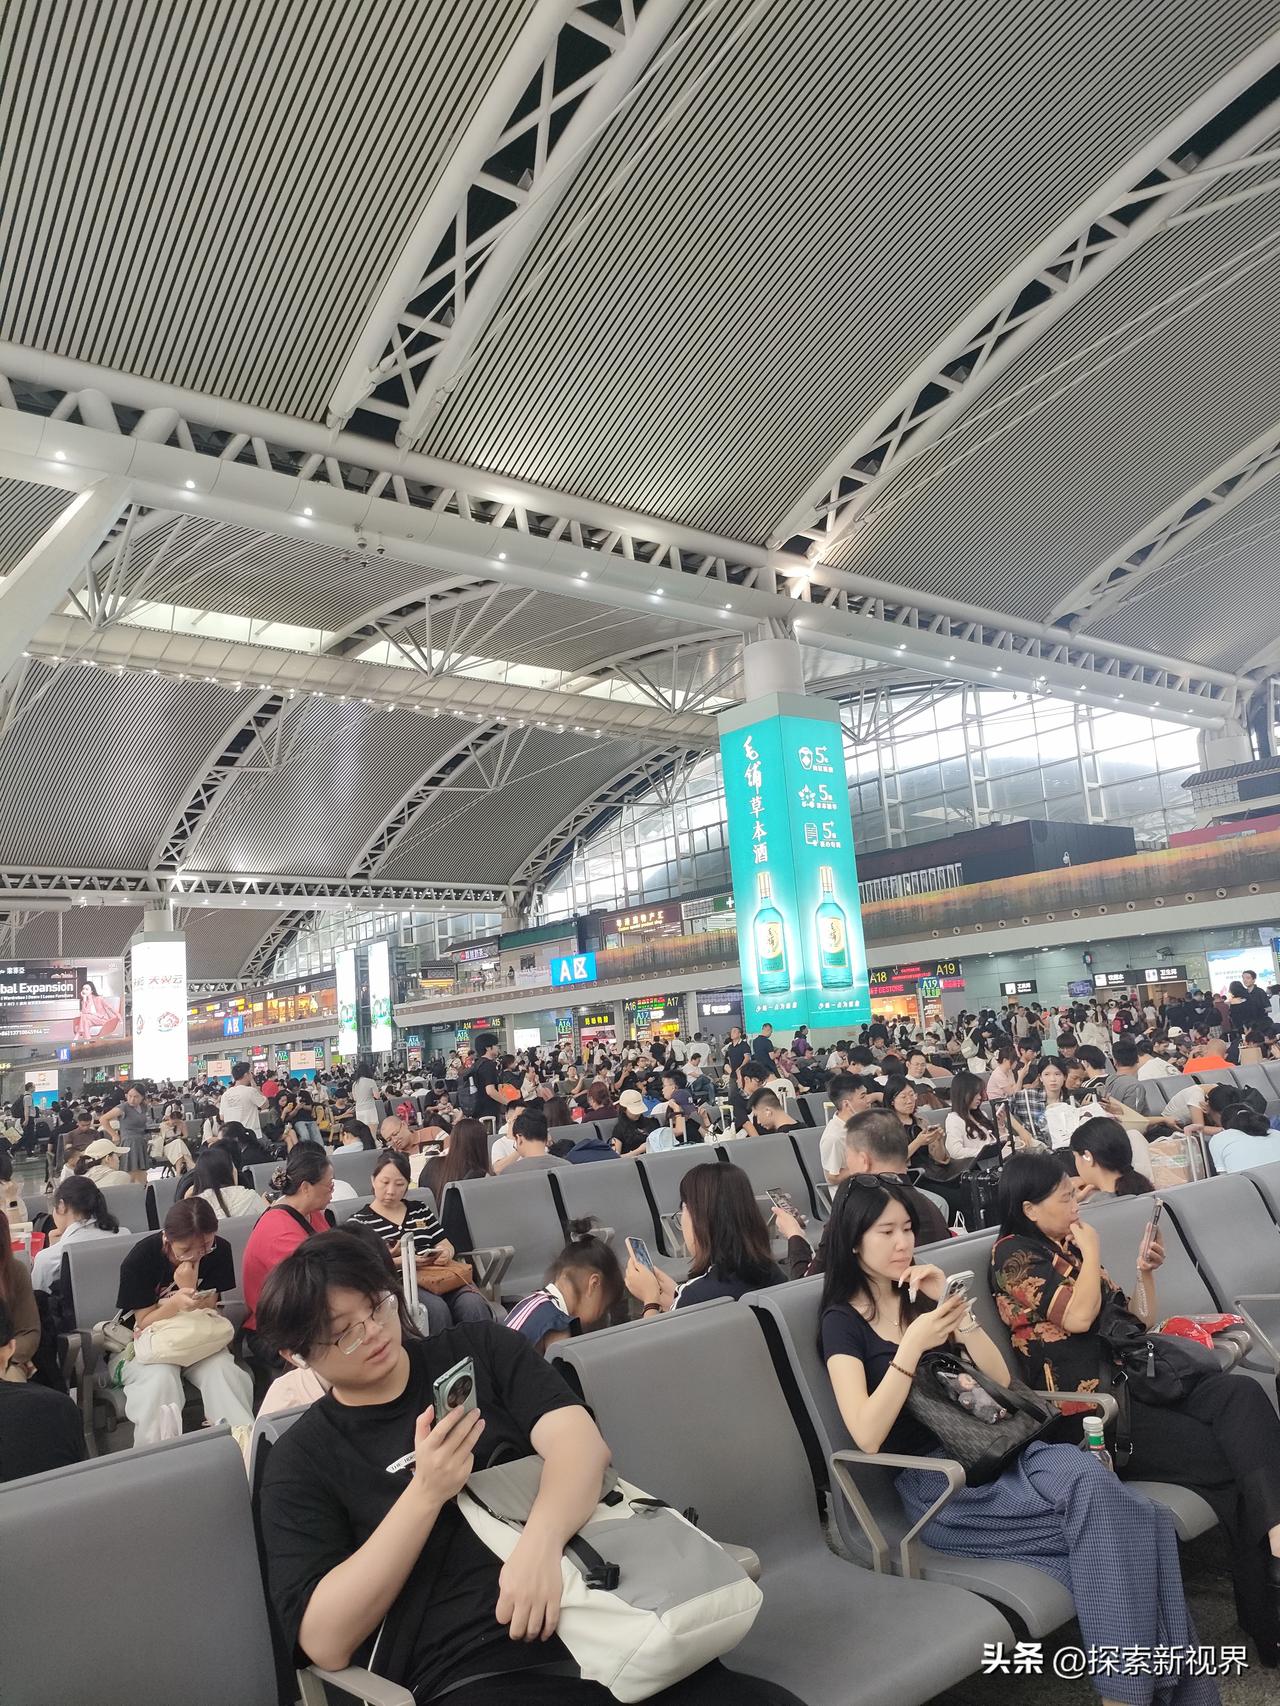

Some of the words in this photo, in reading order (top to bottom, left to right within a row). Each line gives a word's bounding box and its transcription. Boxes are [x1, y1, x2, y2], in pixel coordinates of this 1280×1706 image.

[560, 957, 588, 982] A区
[936, 963, 956, 976] A19
[870, 971, 888, 984] A18
[922, 979, 938, 989] A19
[19, 981, 74, 995] Expansion
[624, 1002, 637, 1012] A16
[667, 996, 679, 1007] A17
